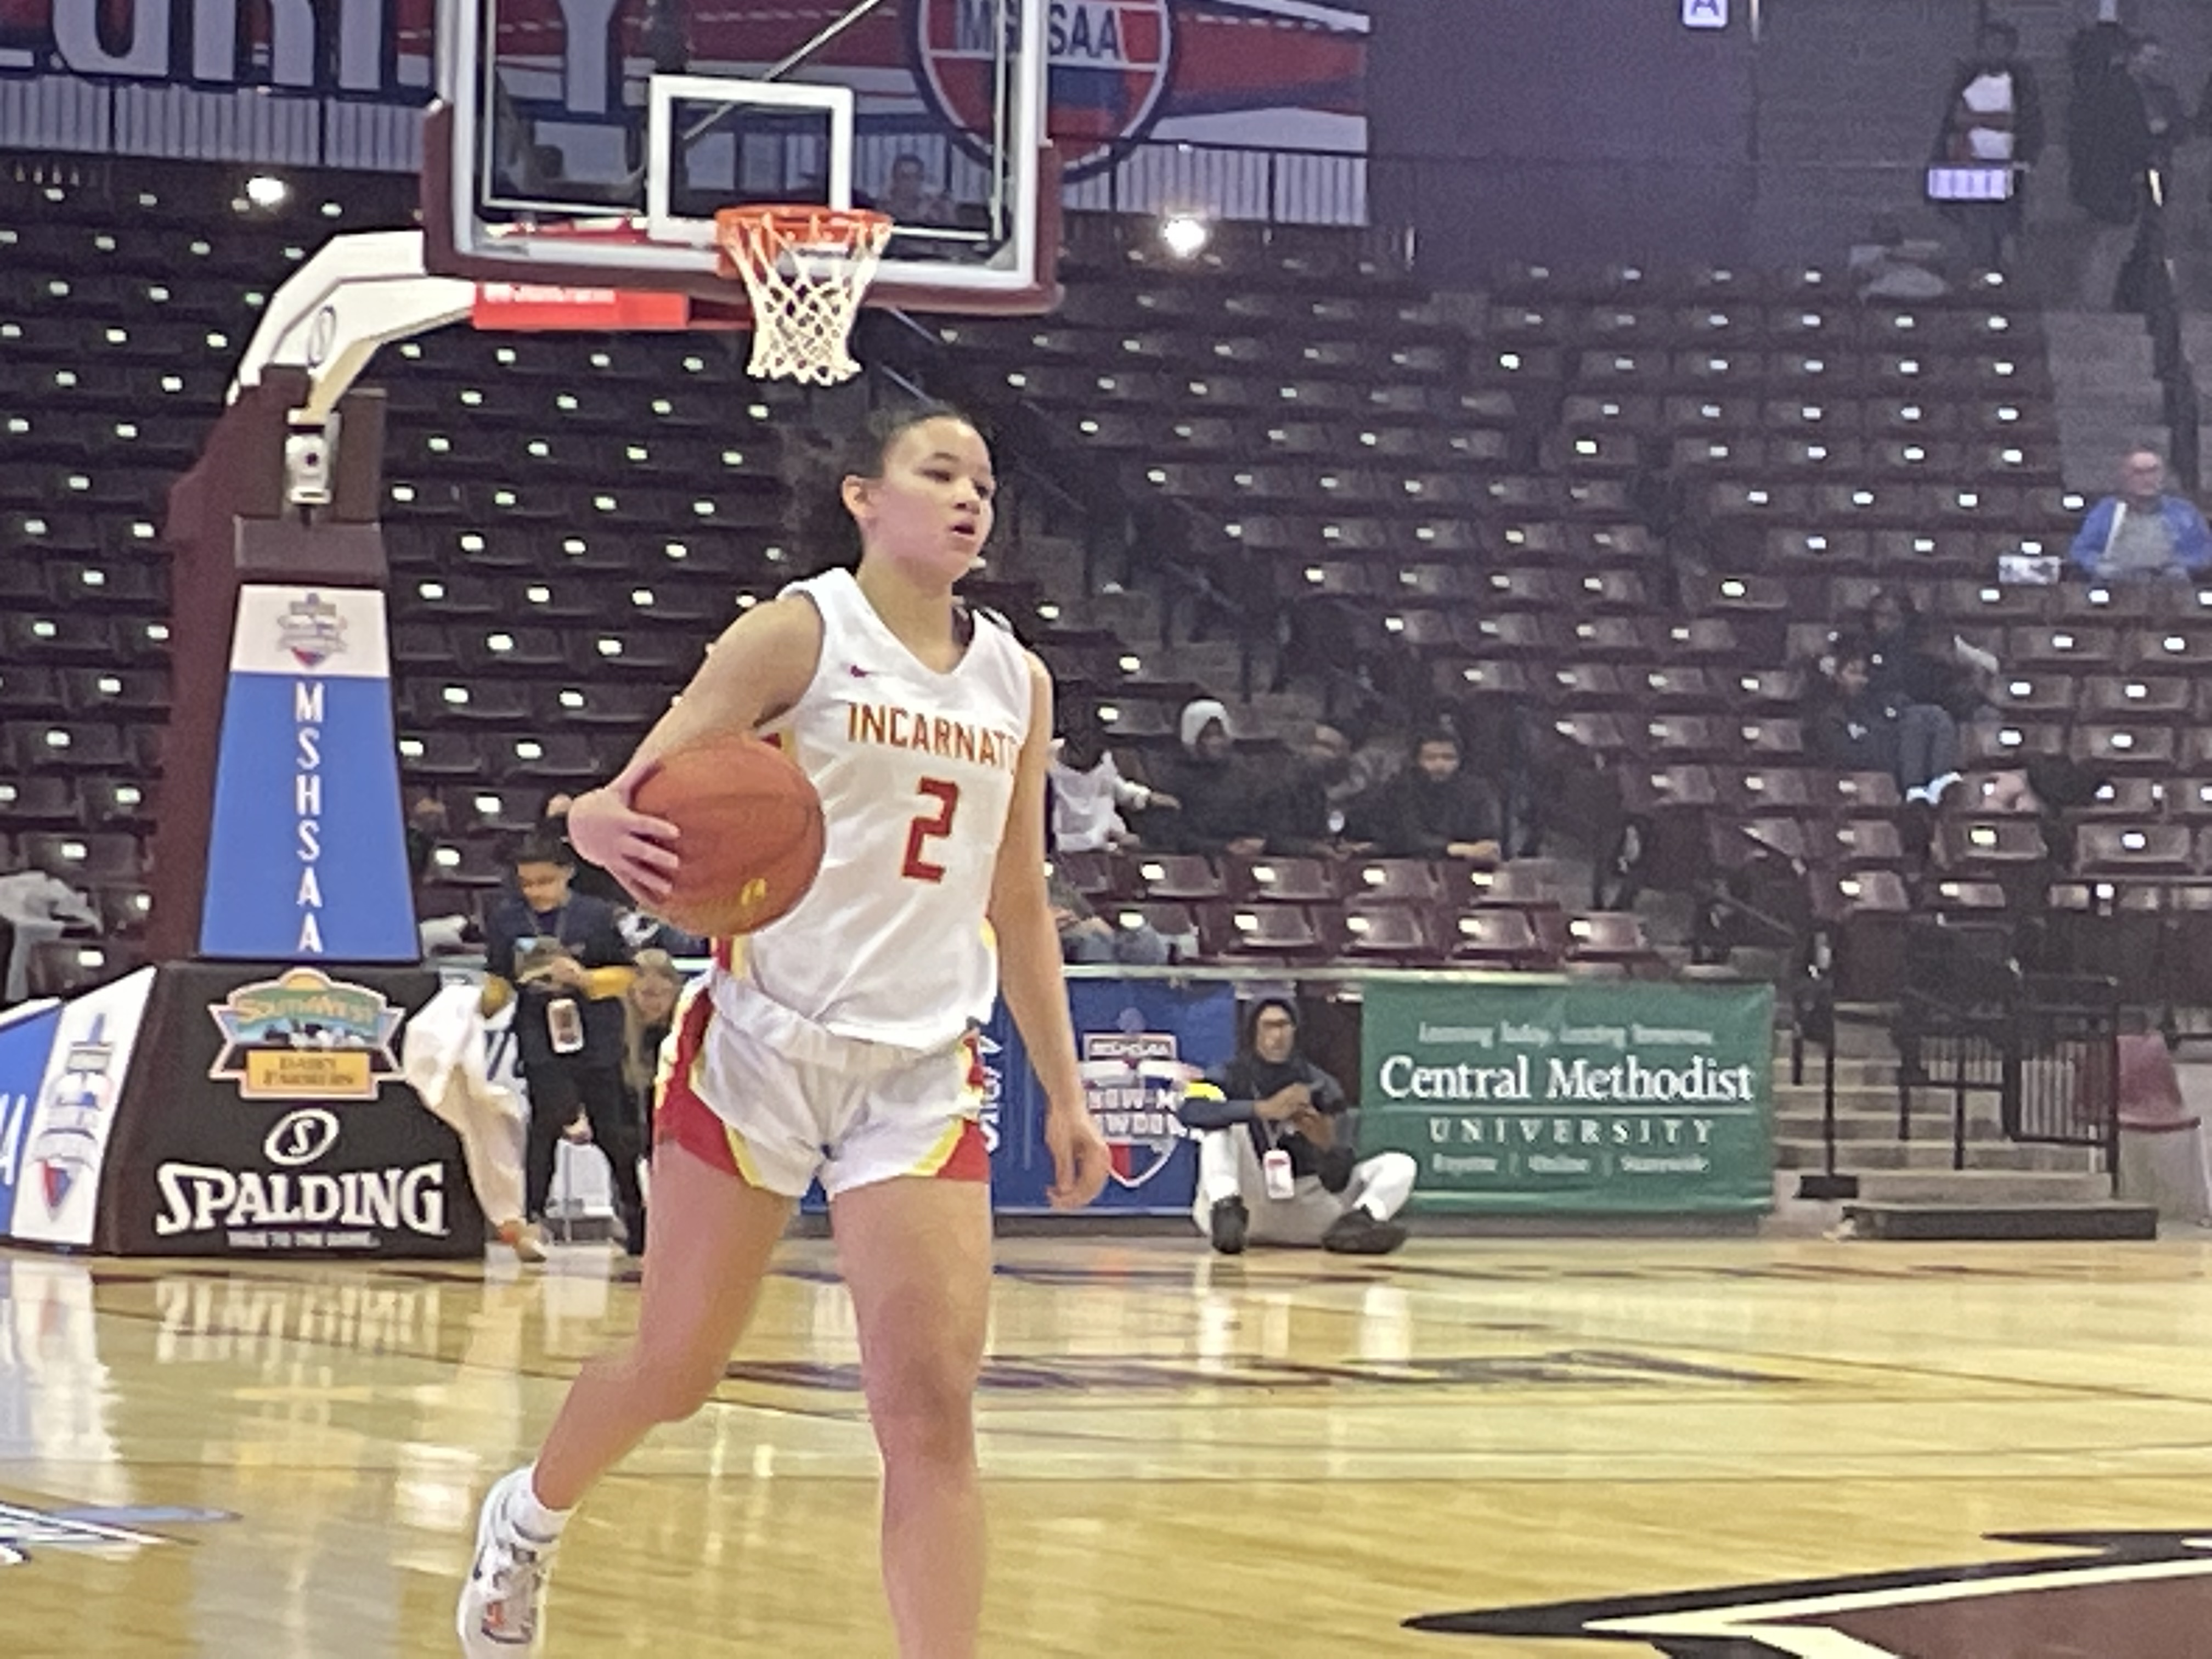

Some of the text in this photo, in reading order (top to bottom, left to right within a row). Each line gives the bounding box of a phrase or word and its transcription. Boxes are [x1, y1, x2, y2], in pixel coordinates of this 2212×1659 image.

[959, 0, 1120, 59] MSSAA
[295, 681, 323, 953] MSHSAA
[901, 776, 959, 884] 2
[1379, 1054, 1754, 1102] Central Methodist
[1430, 1117, 1715, 1144] UNIVERSITY
[156, 1161, 445, 1236] SPALDING
